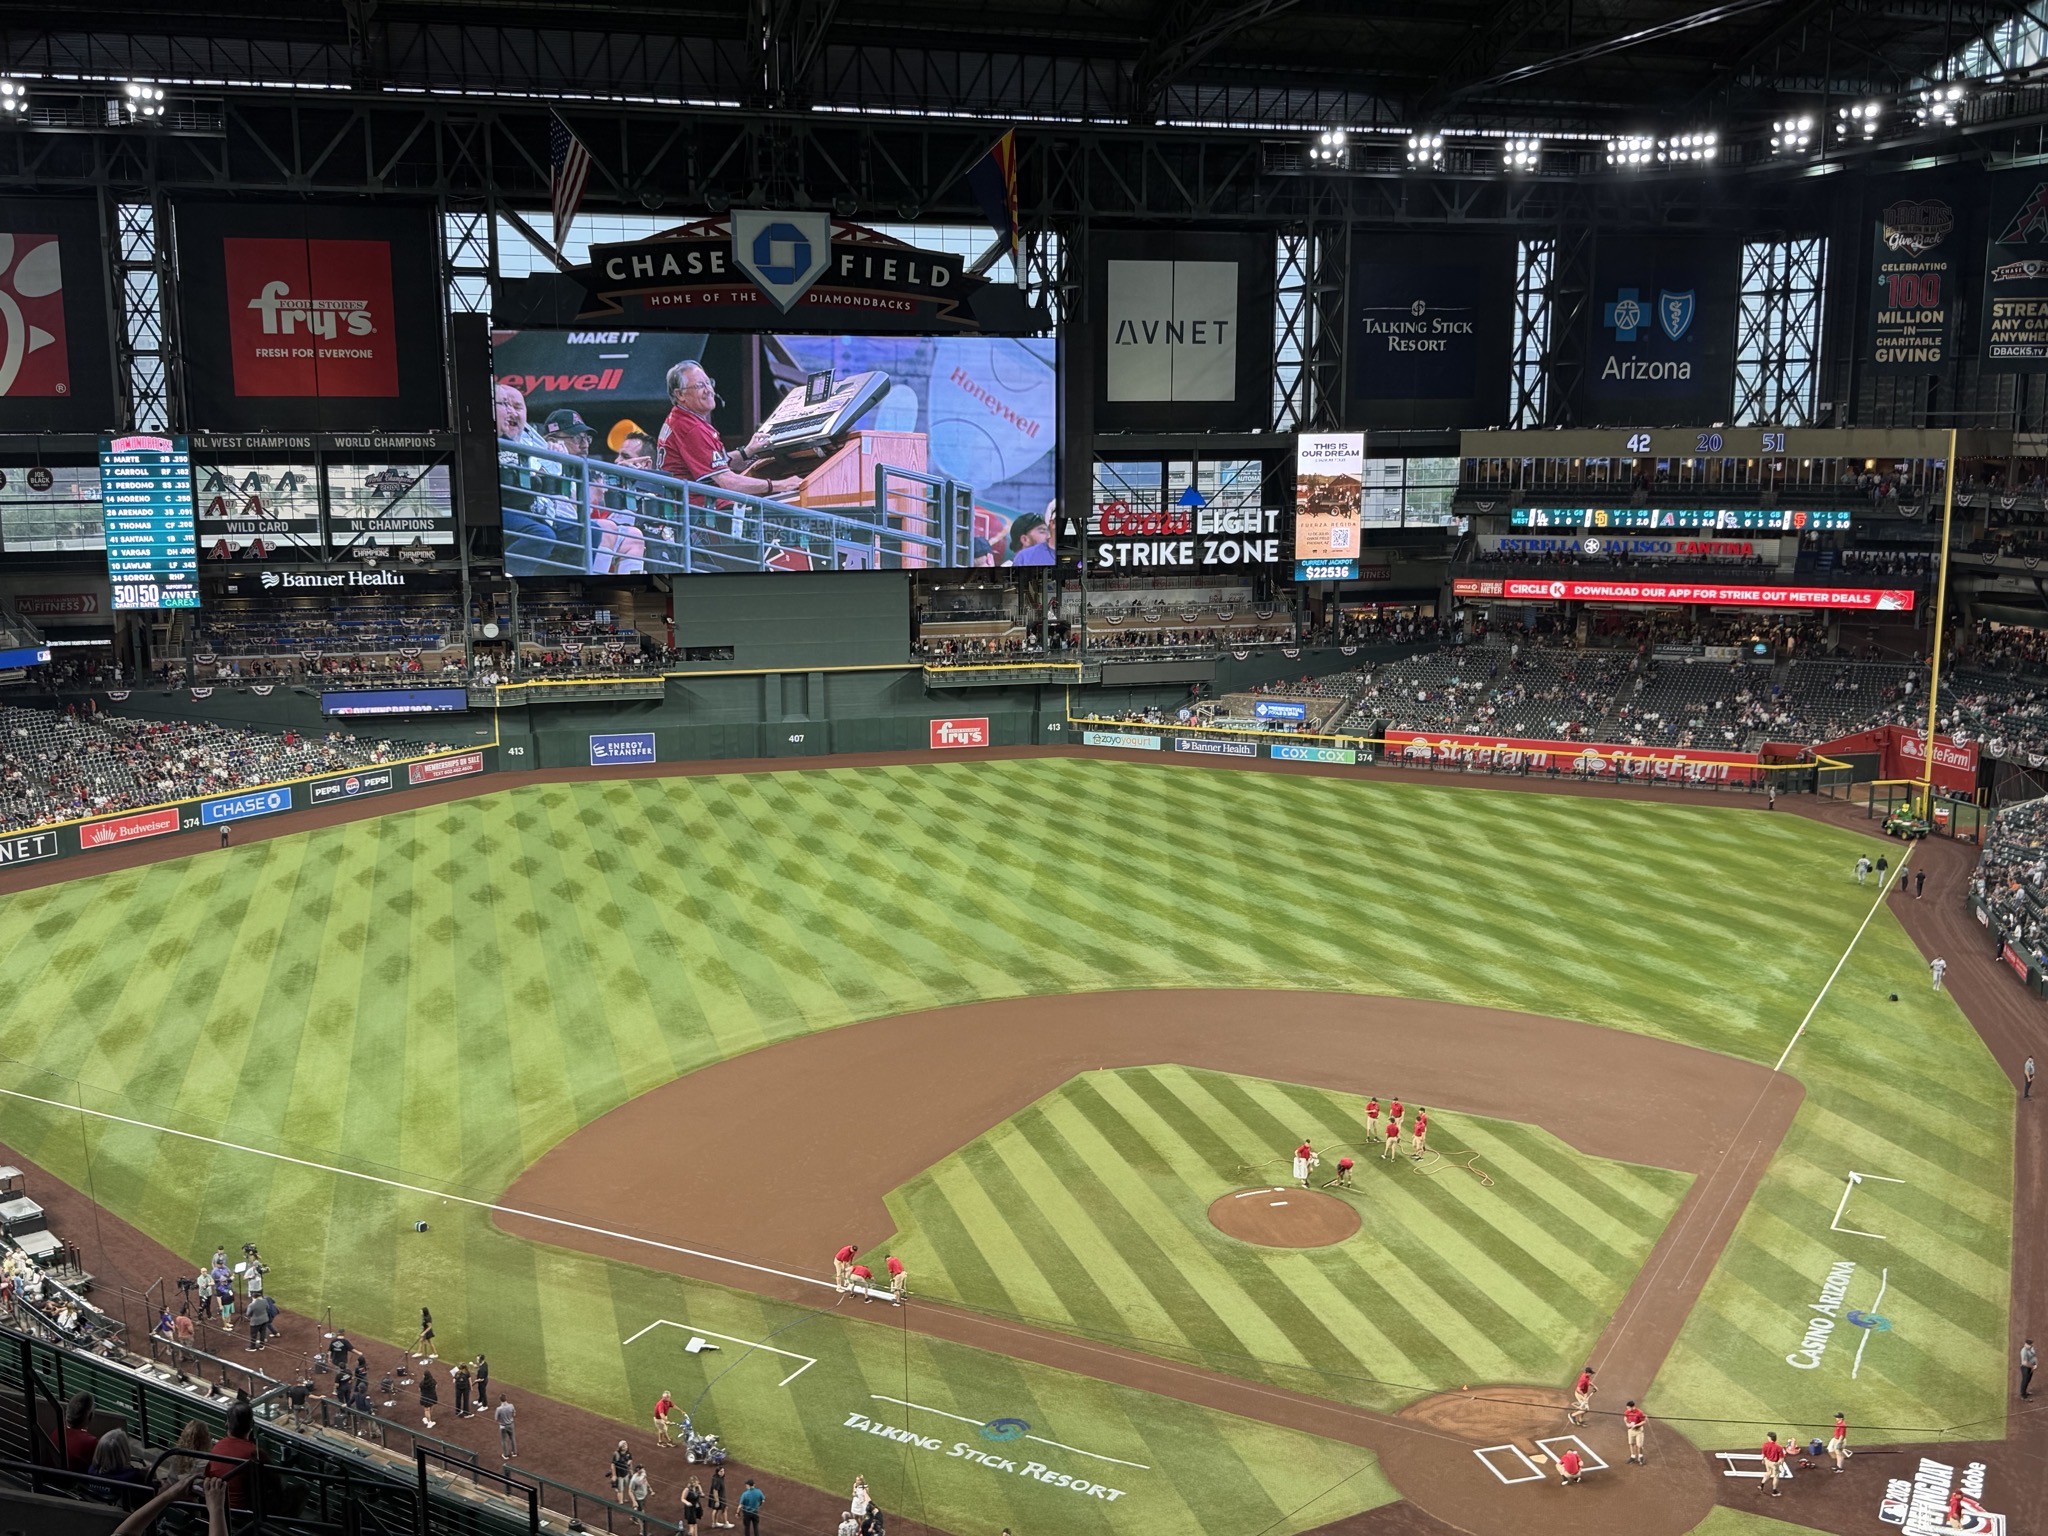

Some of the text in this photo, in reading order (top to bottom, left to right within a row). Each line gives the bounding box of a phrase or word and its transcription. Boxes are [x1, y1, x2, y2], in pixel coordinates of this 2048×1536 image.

[606, 251, 950, 288] CHASE FIELD
[1881, 262, 1947, 271] CELEBRATING
[1878, 273, 1941, 308] $100
[279, 300, 364, 310] FOOD STORES
[651, 292, 912, 311] HOME OF THE DIAMONDBACKS
[247, 280, 373, 340] fry's
[1877, 311, 1944, 324] MILLION
[1362, 318, 1473, 334] TALKING STICK
[1991, 319, 2048, 330] ANY GA
[1115, 320, 1229, 345] AVNET
[1903, 326, 1916, 335] IN
[567, 332, 639, 344] MAKE IT
[1388, 335, 1447, 352] RESORT
[1876, 337, 1942, 346] CHARITABLE
[256, 348, 373, 359] FRESH FOR EVERYONE
[1875, 348, 1941, 362] GIVING
[1993, 345, 2044, 356] DBACKS.TV
[1601, 355, 1691, 380] Arizona
[950, 366, 1040, 438] Honeywell
[194, 437, 311, 448] NL WEST CHAMPIONS
[335, 437, 436, 448] WORLD CHAMPIONS
[1626, 433, 1652, 452] 42
[1695, 433, 1723, 452] 20
[1761, 432, 1785, 453] 51
[1302, 450, 1323, 458] OUR
[223, 476, 233, 484] 99
[260, 475, 269, 483] 01
[295, 475, 305, 483] 02
[225, 500, 235, 508] 07
[262, 499, 270, 507] 11
[1098, 500, 1280, 537] Coors LIGHT
[226, 521, 289, 533] WILD CARD
[351, 519, 435, 531] NL CHAMPIONS
[229, 542, 237, 550] 17
[264, 542, 276, 550] 23
[1500, 538, 1753, 556] ESTRELLA JALISCO CANTINA
[353, 548, 389, 558] CHAMPIONS
[399, 550, 436, 560] CHAMPIONS
[1098, 540, 1279, 568] STRIKE ZONE
[1328, 558, 1353, 566] JACKPOT
[283, 570, 405, 587] Banner Health
[1305, 566, 1349, 580] $22536
[1360, 571, 1391, 579] FITNESS
[161, 590, 199, 599] AVNET
[1510, 584, 1548, 595] CIRCLE
[1574, 586, 1871, 604] DOWNLOAD OUR APP FOR STRIKE OUT METER DEALS
[34, 602, 79, 612] FITNESS
[1047, 723, 1061, 731] 413
[788, 734, 804, 743] 407
[936, 722, 981, 745] fry's
[508, 747, 524, 755] 413
[608, 741, 643, 750] ENERGY
[1191, 742, 1251, 755] Banner Health
[608, 747, 653, 757] TRANSFER
[1281, 747, 1308, 759] COX
[1317, 750, 1345, 761] COX
[1357, 753, 1373, 762] 374
[424, 759, 460, 772] MEMBERSHIPS
[467, 755, 480, 764] SALE
[364, 776, 389, 787] PEPSI
[315, 785, 341, 796] PEPSI
[212, 798, 266, 819] CHASE
[119, 818, 171, 837] Budweiser
[183, 818, 200, 829] 374
[1785, 1261, 1857, 1370] CASINO ARIZONA
[843, 1411, 1127, 1502] TALKING STICK RESORT
[1960, 1461, 1987, 1499] Adobe
[1885, 1478, 1912, 1503] 2026
